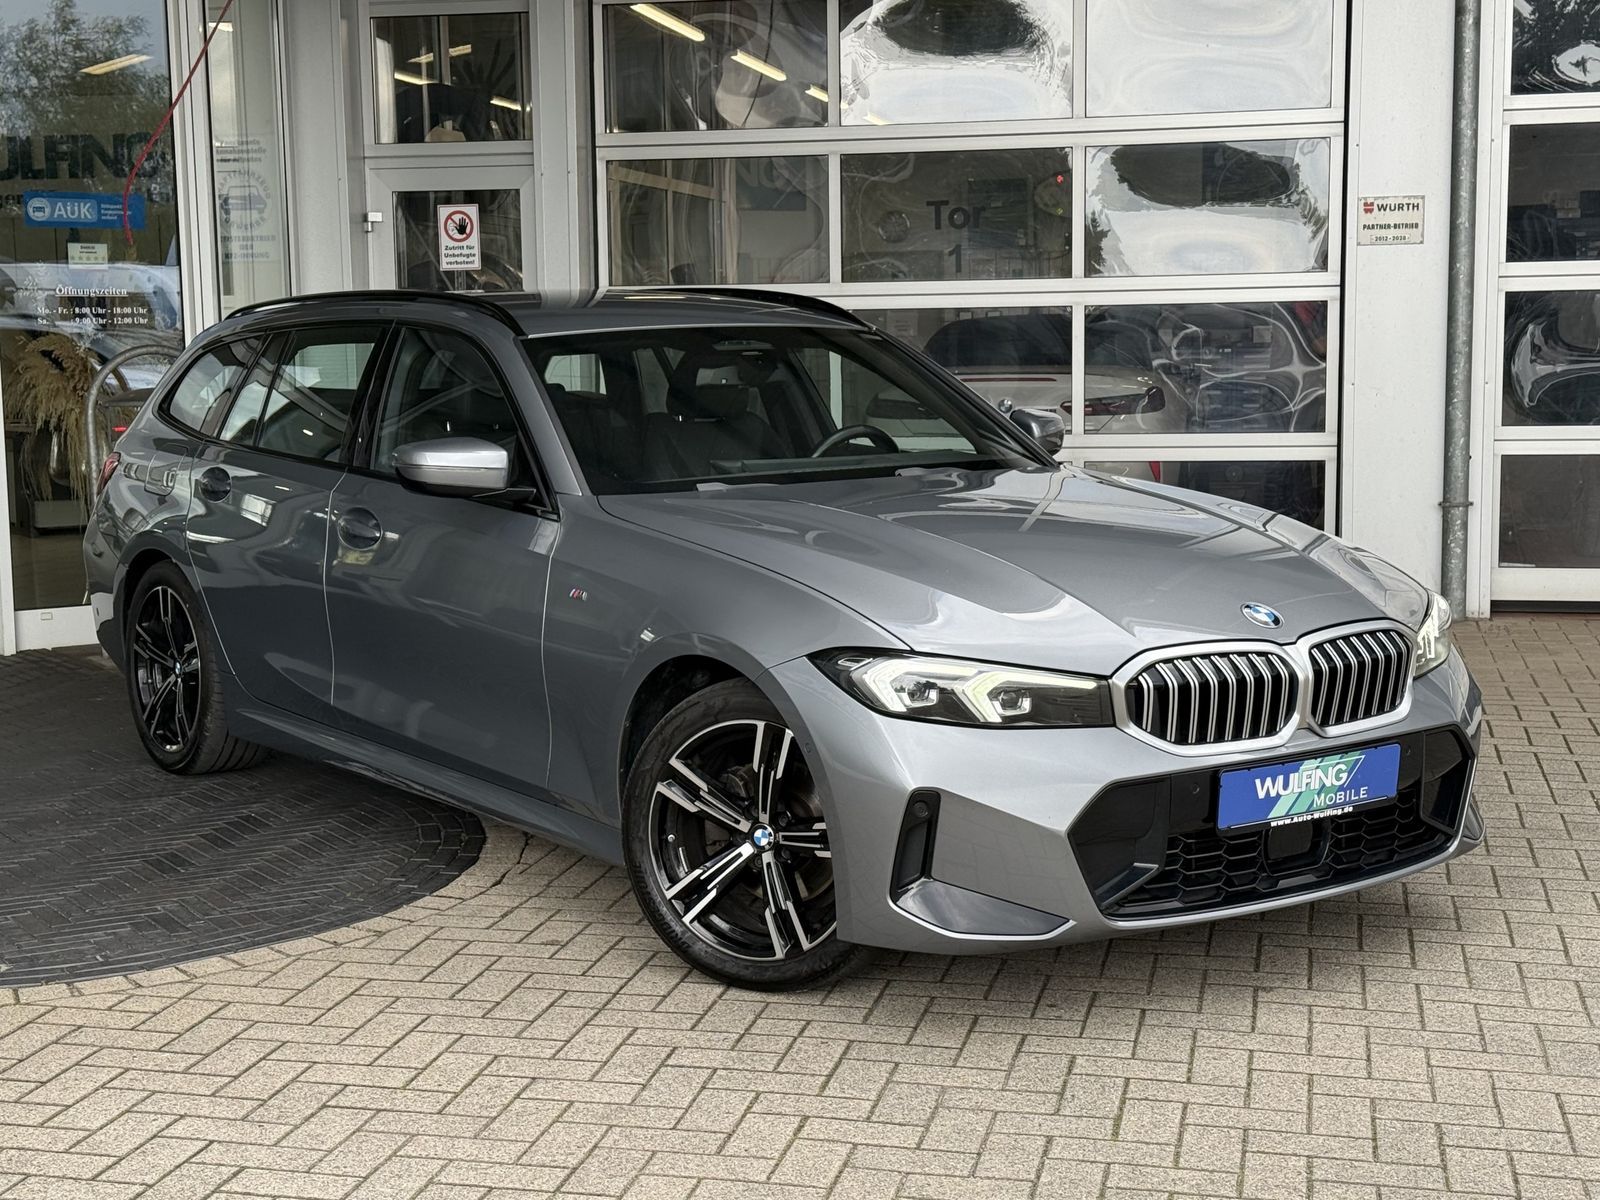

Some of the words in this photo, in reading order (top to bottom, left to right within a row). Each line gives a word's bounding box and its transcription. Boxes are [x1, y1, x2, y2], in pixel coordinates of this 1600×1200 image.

[926, 200, 986, 230] Tor
[1362, 222, 1419, 231] PARTNER-BETRIEB
[948, 244, 962, 273] 1
[55, 283, 129, 297] Öffnungszeiten
[37, 306, 52, 315] Mo.
[58, 306, 69, 315] Fr.
[74, 306, 91, 315] 8:00
[92, 306, 107, 315] Uhr
[112, 306, 132, 315] 18:00
[133, 306, 148, 315] Uhr
[92, 316, 107, 325] Uhr
[113, 316, 132, 325] 12:00
[133, 316, 149, 325] Uhr
[1254, 763, 1349, 799] WULFING
[1313, 786, 1370, 808] MOBILE
[1270, 806, 1354, 828] www.Auto-Wulfing.de
